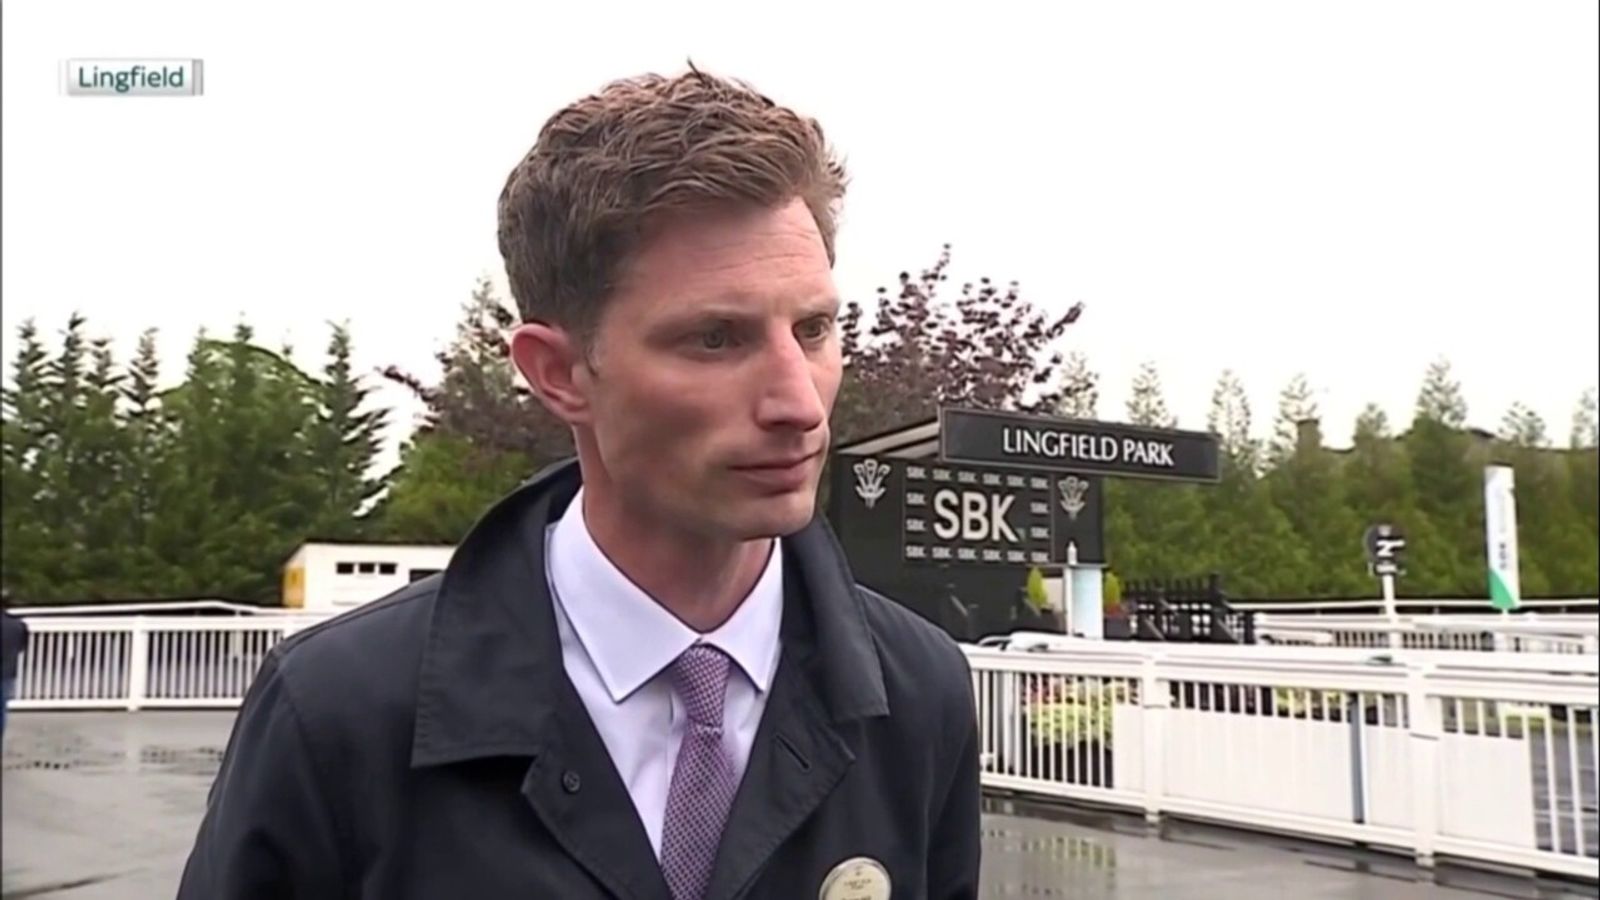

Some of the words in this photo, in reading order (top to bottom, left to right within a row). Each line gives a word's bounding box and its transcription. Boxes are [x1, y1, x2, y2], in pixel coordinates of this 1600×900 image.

[1003, 427, 1118, 462] LINGFIELD
[1122, 438, 1174, 466] PARK
[906, 467, 926, 479] SBK
[933, 468, 951, 481] SBK
[958, 471, 977, 483] SBK
[983, 473, 1001, 485] SBK
[1007, 475, 1025, 487] SBK
[1031, 478, 1048, 489] SBK
[906, 493, 926, 505] SBK
[934, 489, 1019, 542] SBK
[1031, 503, 1048, 514] SBK
[906, 519, 926, 531] SBK
[1031, 527, 1048, 538] SBK
[906, 546, 926, 558] SBK
[933, 547, 952, 558] SBK
[958, 548, 977, 559] SBK
[983, 550, 1001, 560] SBK
[1007, 551, 1026, 561] SBK
[1031, 552, 1048, 562] SBK
